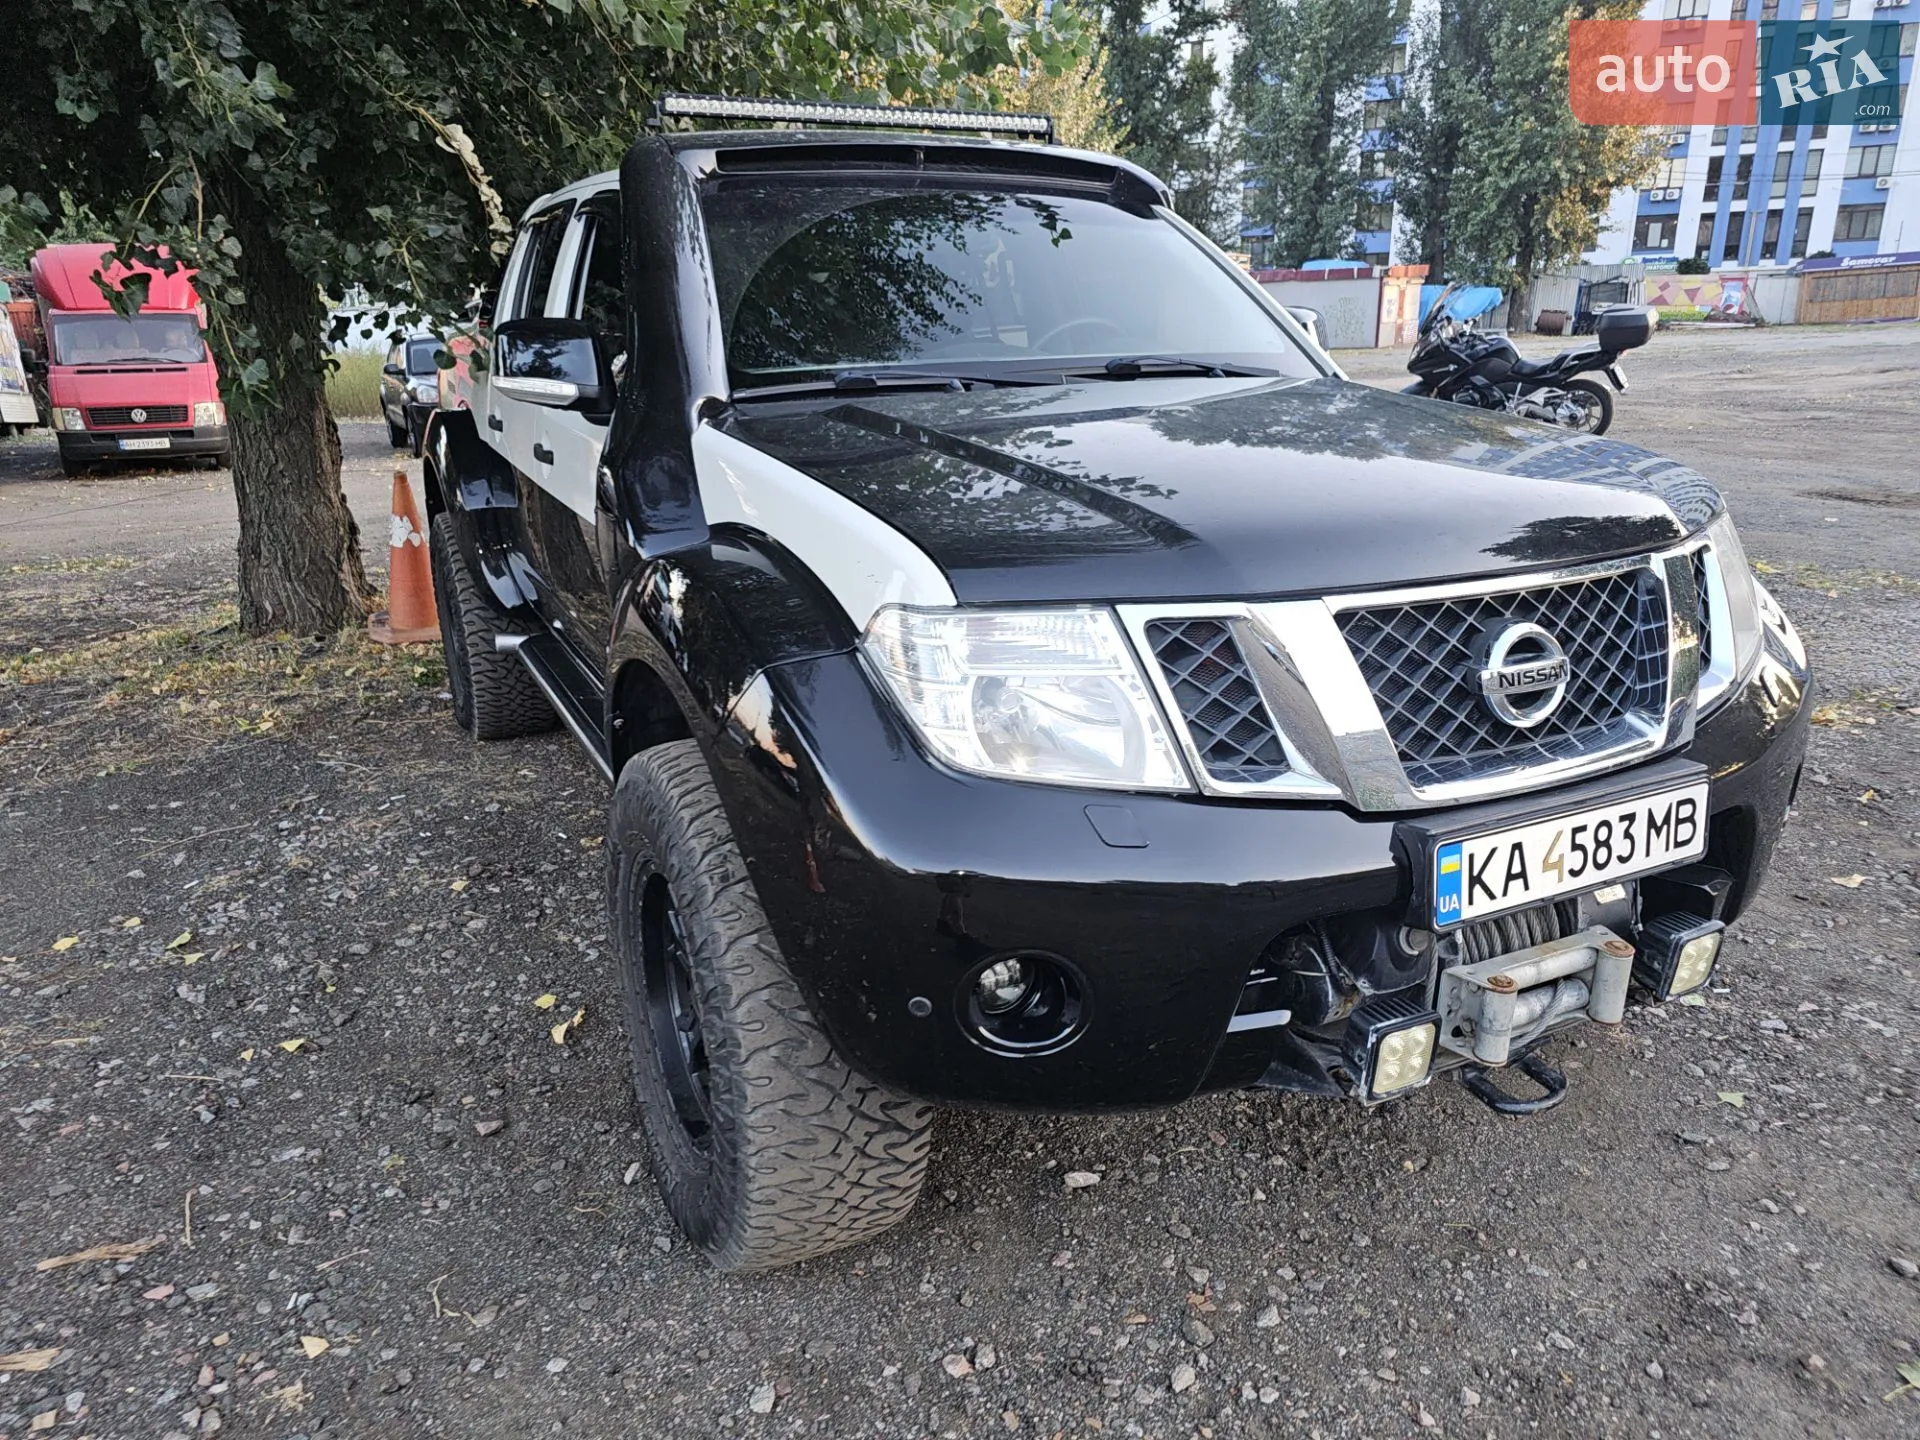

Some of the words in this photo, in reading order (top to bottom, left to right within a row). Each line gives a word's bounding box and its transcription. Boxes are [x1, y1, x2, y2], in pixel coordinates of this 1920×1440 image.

[1499, 660, 1567, 688] NISSAN
[1468, 842, 1530, 906] KA
[1542, 811, 1637, 884] 4583
[1645, 797, 1697, 858] MB
[1440, 895, 1460, 913] UA
